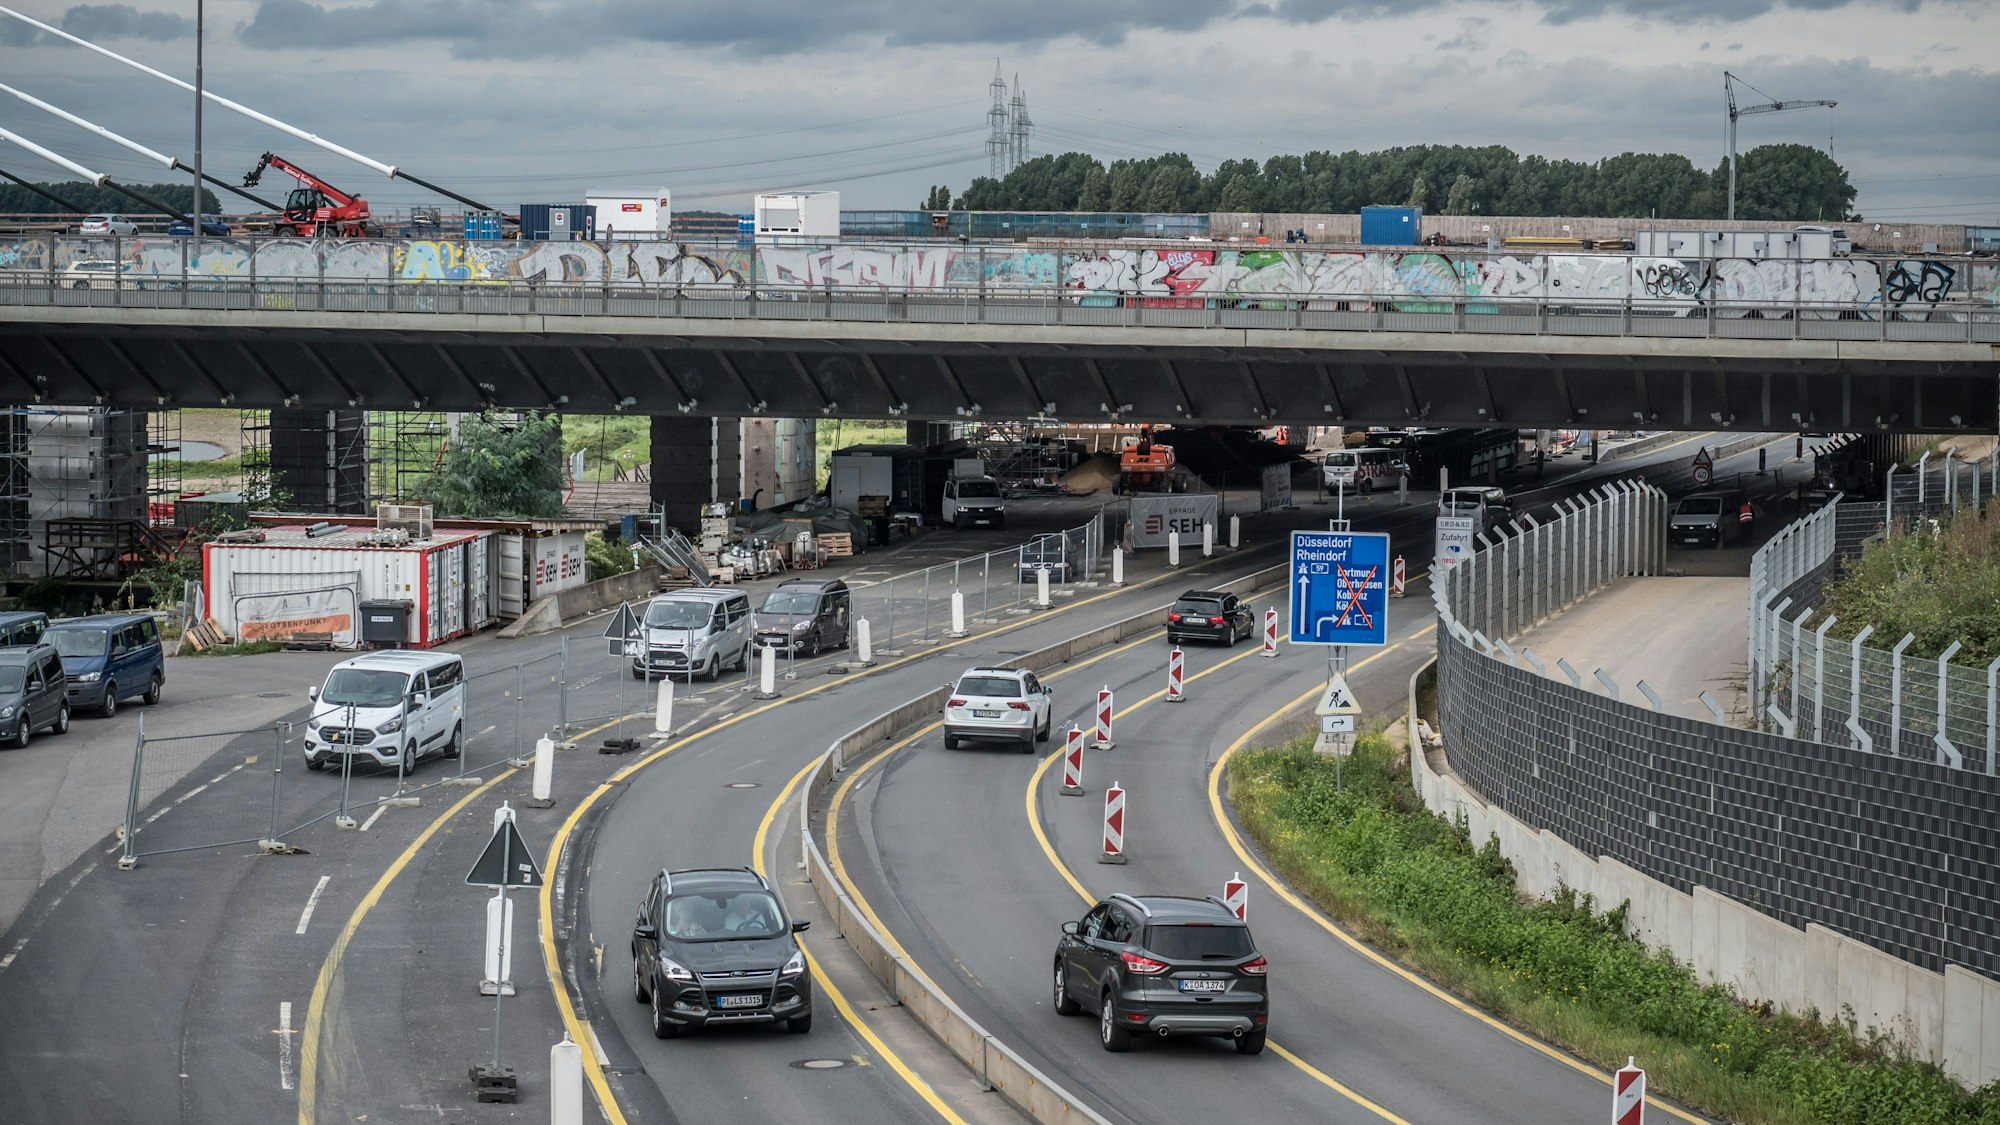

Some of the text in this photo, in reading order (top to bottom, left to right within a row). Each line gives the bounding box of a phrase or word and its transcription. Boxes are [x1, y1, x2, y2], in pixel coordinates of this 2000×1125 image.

[1359, 464, 1400, 479] STRAB
[1697, 471, 1706, 479] 40
[1169, 518, 1203, 533] SEH
[1297, 535, 1352, 548] Düsseldorf
[1440, 533, 1468, 541] Zufahrt
[1296, 549, 1347, 562] Rheindorf
[545, 563, 558, 583] SEH
[569, 557, 581, 577] SEH
[1336, 578, 1383, 590] Obrhausen
[1336, 590, 1368, 600] Kobnz
[264, 618, 327, 629] LOTSENPUNKT
[1194, 981, 1205, 989] OA
[1206, 981, 1224, 989] 1374
[744, 996, 761, 1004] 1315
